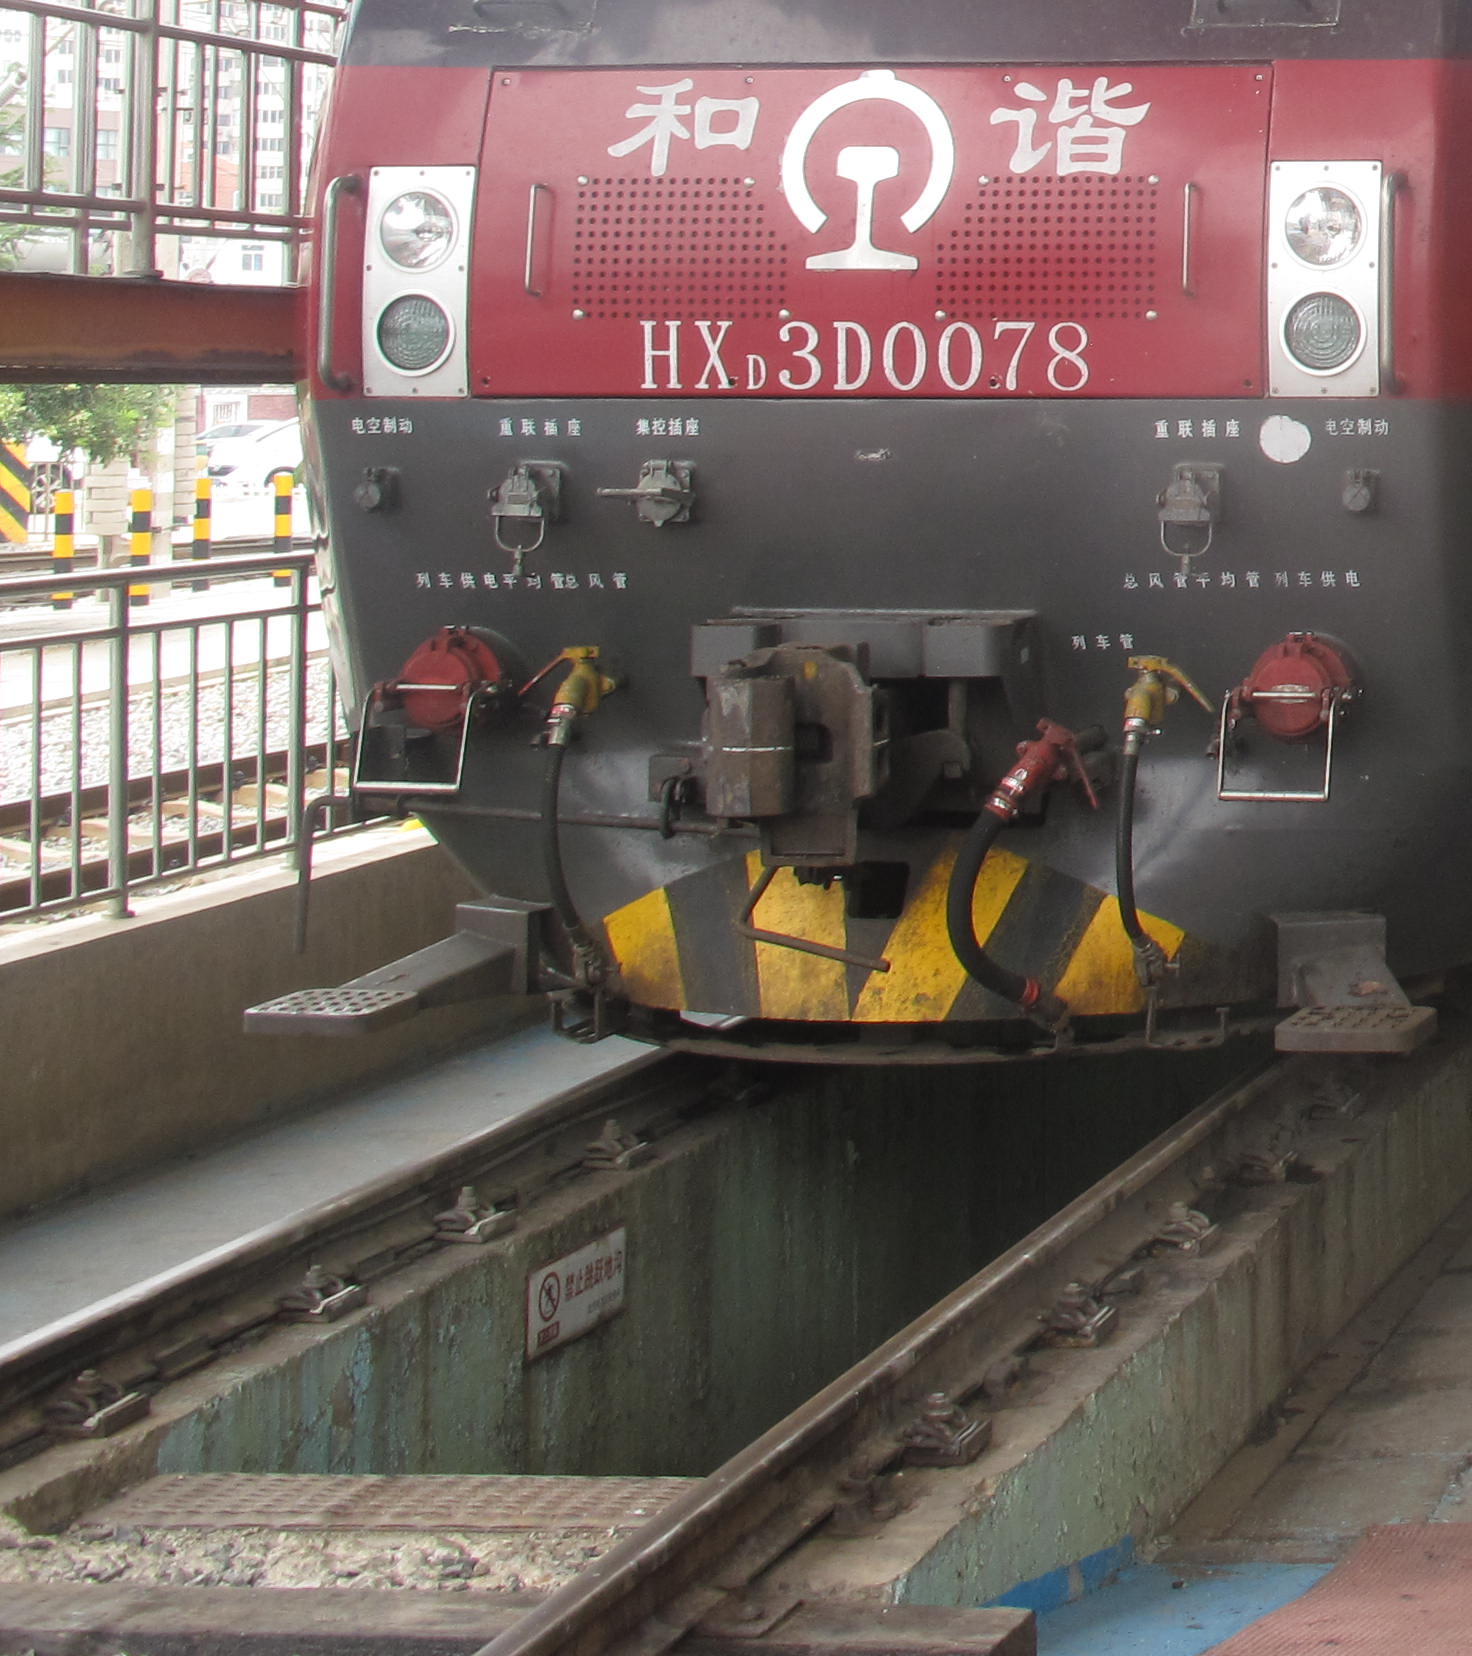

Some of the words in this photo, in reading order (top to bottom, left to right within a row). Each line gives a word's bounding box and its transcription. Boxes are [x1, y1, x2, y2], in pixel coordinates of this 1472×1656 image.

[608, 77, 760, 176] 和
[989, 76, 1152, 175] 谐
[639, 320, 1090, 392] HXD3D0078
[351, 417, 414, 435] 电空制动
[499, 417, 583, 437] 重联插座
[635, 417, 701, 437] 集控插座
[1153, 418, 1241, 439] 重联插座
[1324, 417, 1389, 436] 电空制动
[1071, 633, 1135, 650] 列车管
